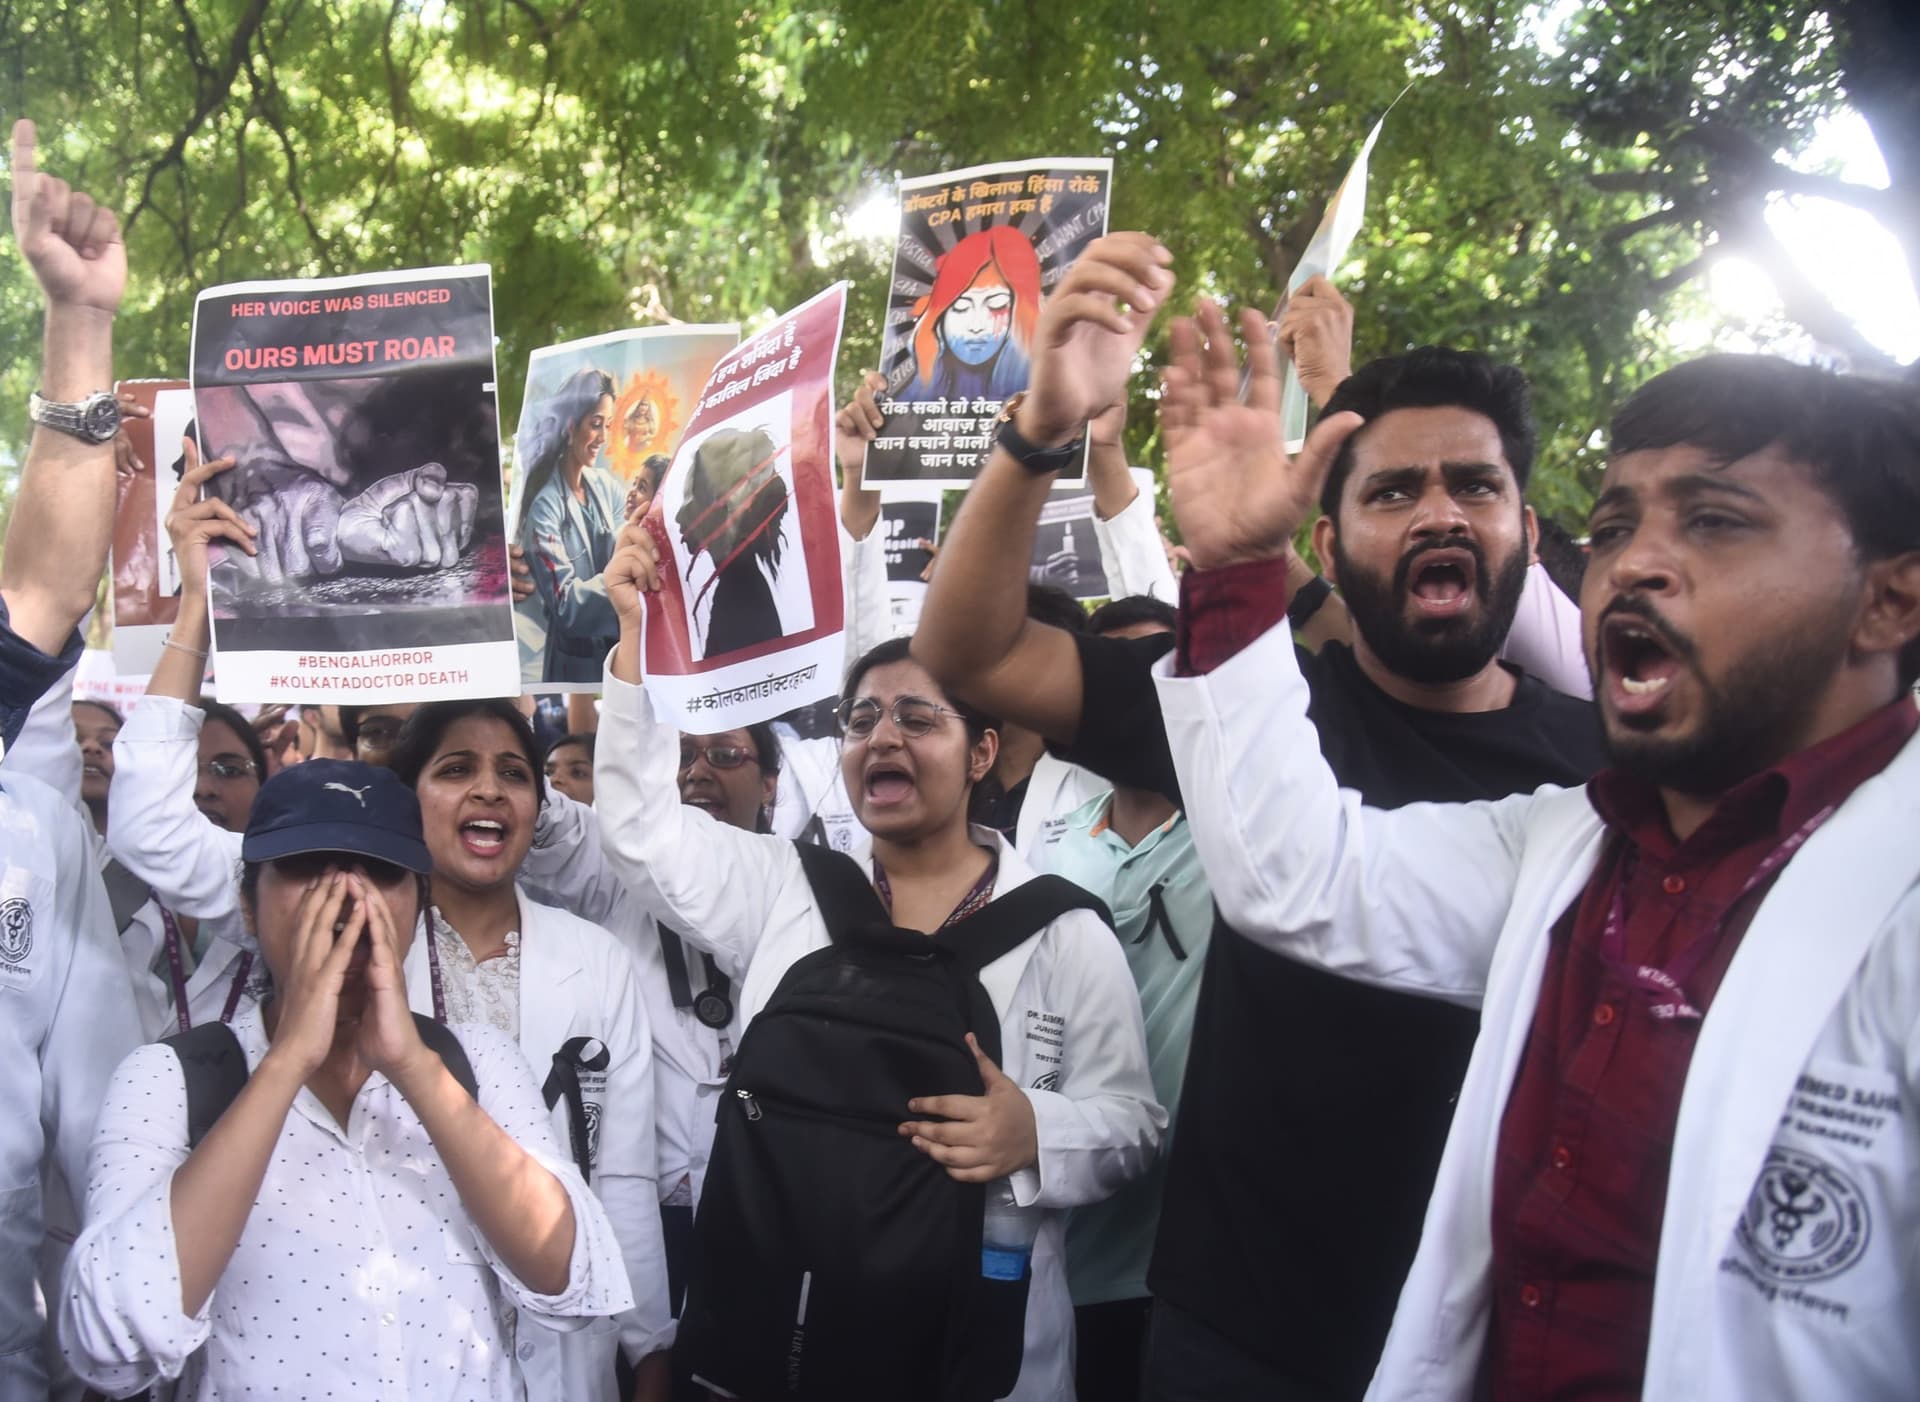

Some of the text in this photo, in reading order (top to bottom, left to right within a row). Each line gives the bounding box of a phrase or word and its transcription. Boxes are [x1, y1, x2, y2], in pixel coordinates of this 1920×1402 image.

[928, 207, 961, 226] CPA
[1051, 213, 1085, 248] WANT
[900, 234, 934, 268] JUSTICE
[231, 288, 451, 318] HER VOICE WAS SILENCED
[224, 335, 456, 371] OURS MUST ROAR
[717, 361, 739, 383] हम
[705, 376, 753, 409] कातिल
[881, 397, 909, 415] रोक
[912, 396, 948, 415] सको
[950, 397, 968, 415] तो
[922, 418, 977, 434] आवाज़
[874, 436, 906, 451] जान
[920, 453, 954, 468] जान
[956, 453, 978, 467] पर
[298, 651, 433, 669] #BENGALHORROR
[270, 669, 469, 689] #KOLKATADOCTOR DEATH
